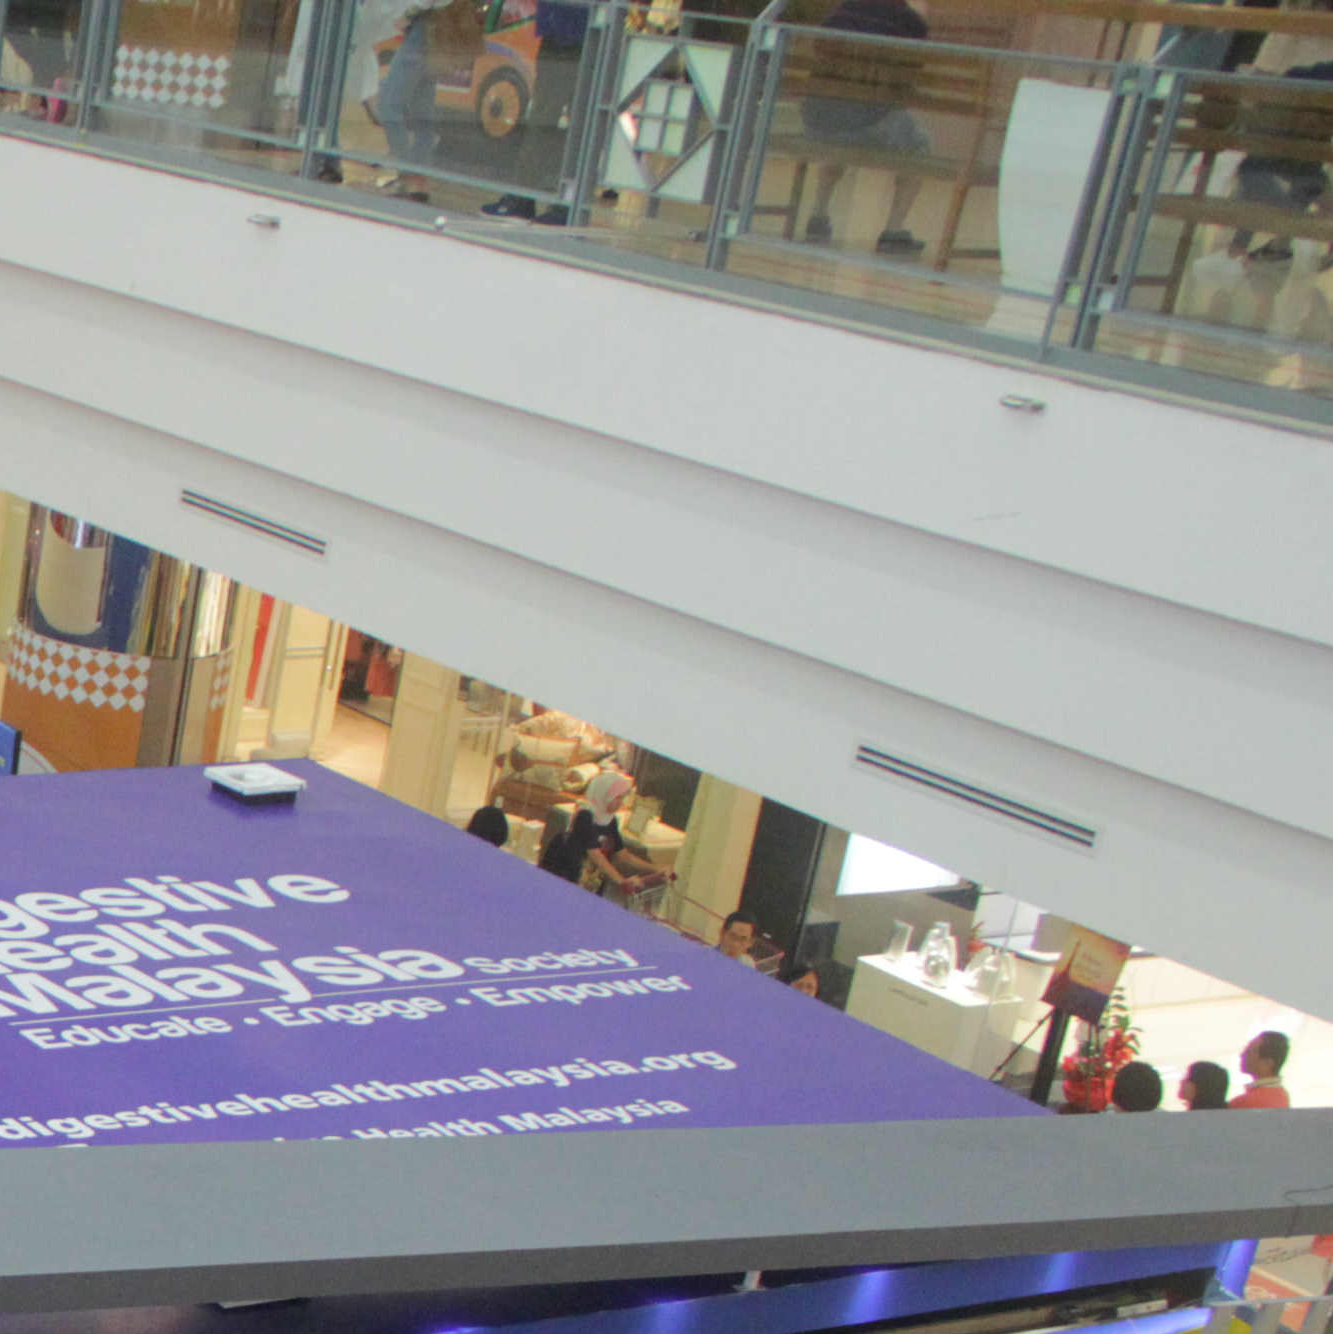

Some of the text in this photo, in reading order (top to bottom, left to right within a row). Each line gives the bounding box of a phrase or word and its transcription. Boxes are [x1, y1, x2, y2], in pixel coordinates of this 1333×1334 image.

[463, 948, 640, 976] Society
[18, 974, 693, 1052] Educate Engage Empower
[498, 1098, 691, 1134] Malaysia
